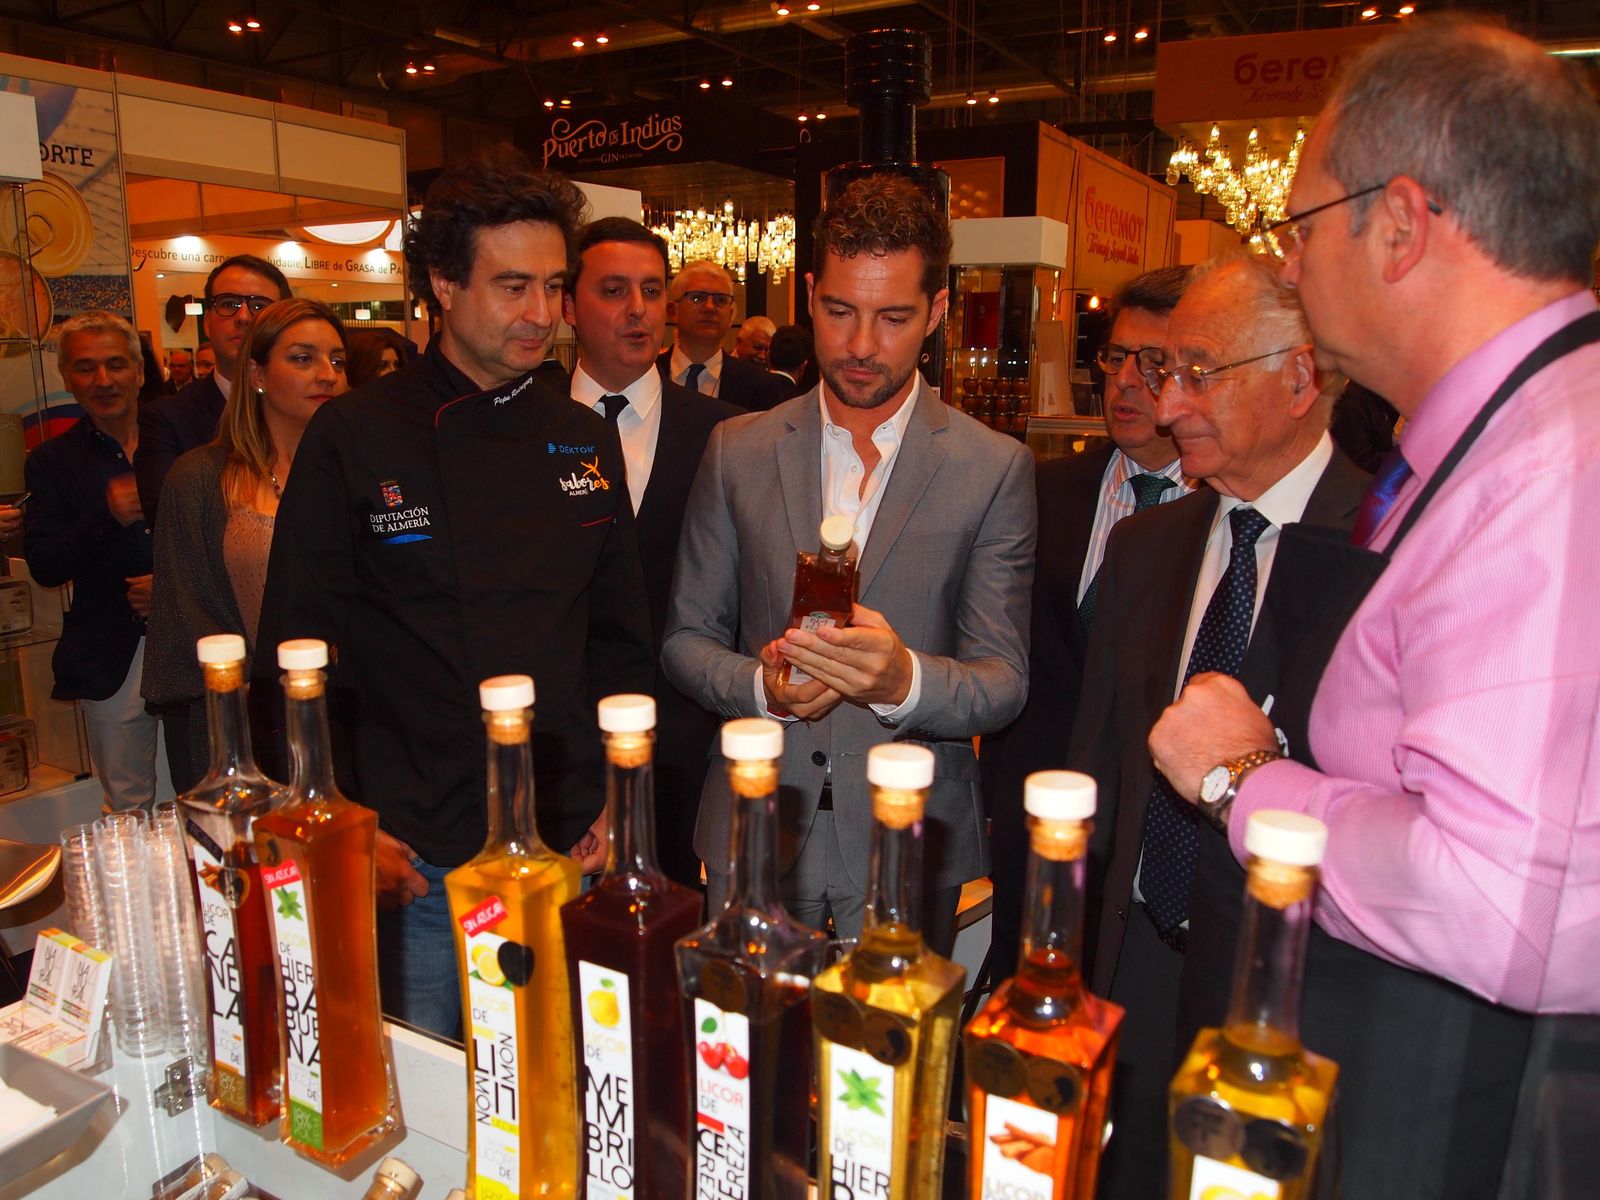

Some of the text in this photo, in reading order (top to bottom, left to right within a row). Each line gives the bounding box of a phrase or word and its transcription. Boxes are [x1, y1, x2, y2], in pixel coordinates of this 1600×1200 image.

[542, 118, 607, 169] Puerto
[620, 113, 683, 152] Indias
[600, 152, 619, 164] GIN
[181, 252, 201, 262] una
[305, 256, 329, 270] LIBRE
[333, 260, 344, 271] de
[345, 259, 375, 274] GRASA
[378, 263, 388, 275] de
[558, 445, 594, 455] DEKTON
[559, 472, 610, 492] sabores
[369, 506, 429, 524] DIPUTACIÓN
[372, 516, 431, 533] DE ALMERÍA
[203, 901, 230, 920] LICOR
[204, 912, 216, 927] DE
[280, 941, 292, 956] DE
[472, 1007, 488, 1024] DE
[586, 1044, 603, 1061] DE
[306, 1088, 317, 1100] DE
[699, 1077, 745, 1109] LICOR
[700, 1095, 719, 1114] DE
[834, 1137, 857, 1158] DE
[498, 1166, 512, 1181] DE
